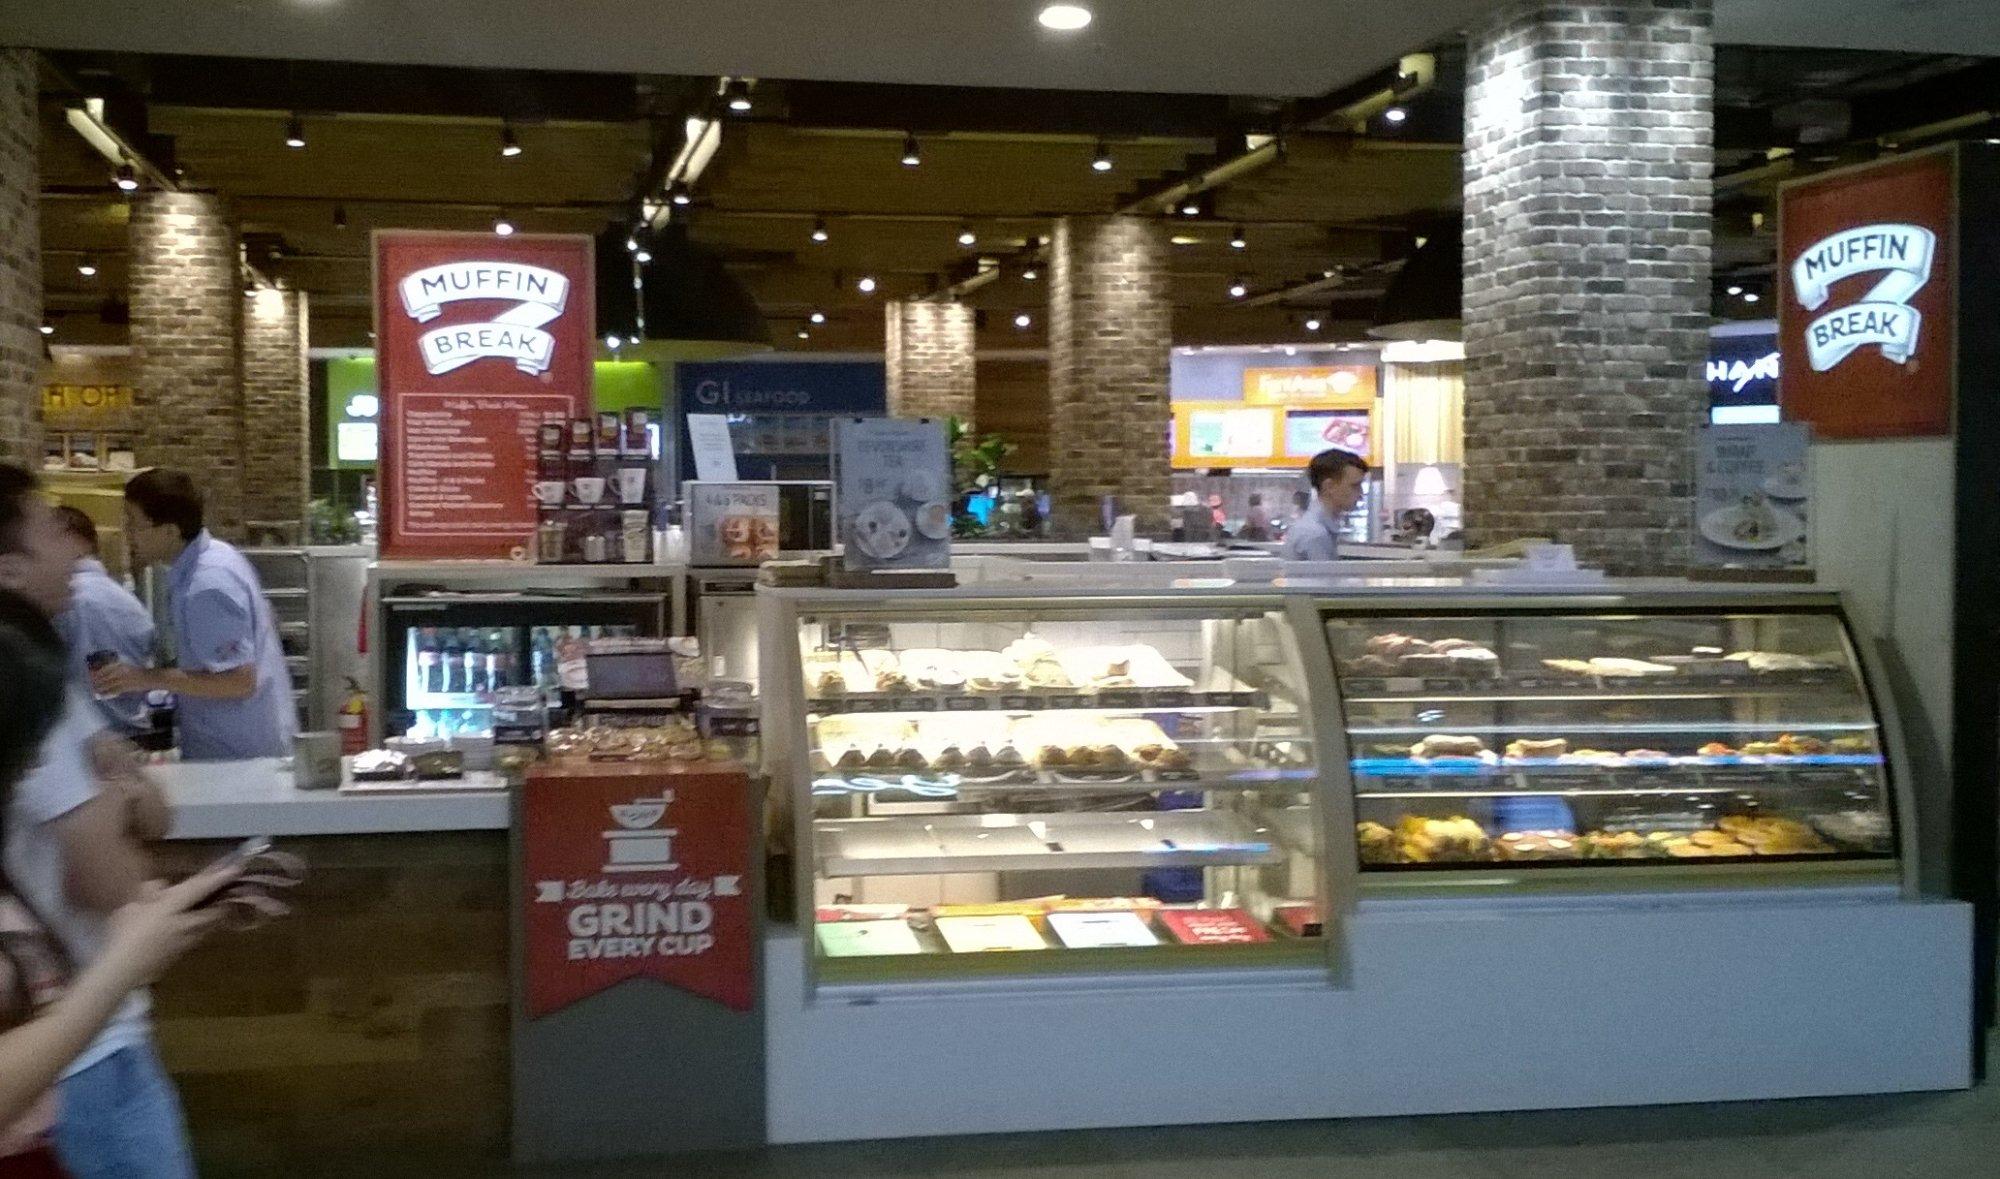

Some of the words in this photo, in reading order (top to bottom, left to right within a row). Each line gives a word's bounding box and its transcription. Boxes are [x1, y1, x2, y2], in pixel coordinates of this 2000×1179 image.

[1804, 233, 1909, 279] MUFFIN
[420, 269, 549, 296] MUFFIN
[434, 330, 537, 354] BREAK
[1812, 310, 1899, 347] BREAK
[567, 901, 715, 938] GRIND
[567, 937, 656, 961] EVERY
[658, 934, 715, 956] CUP
